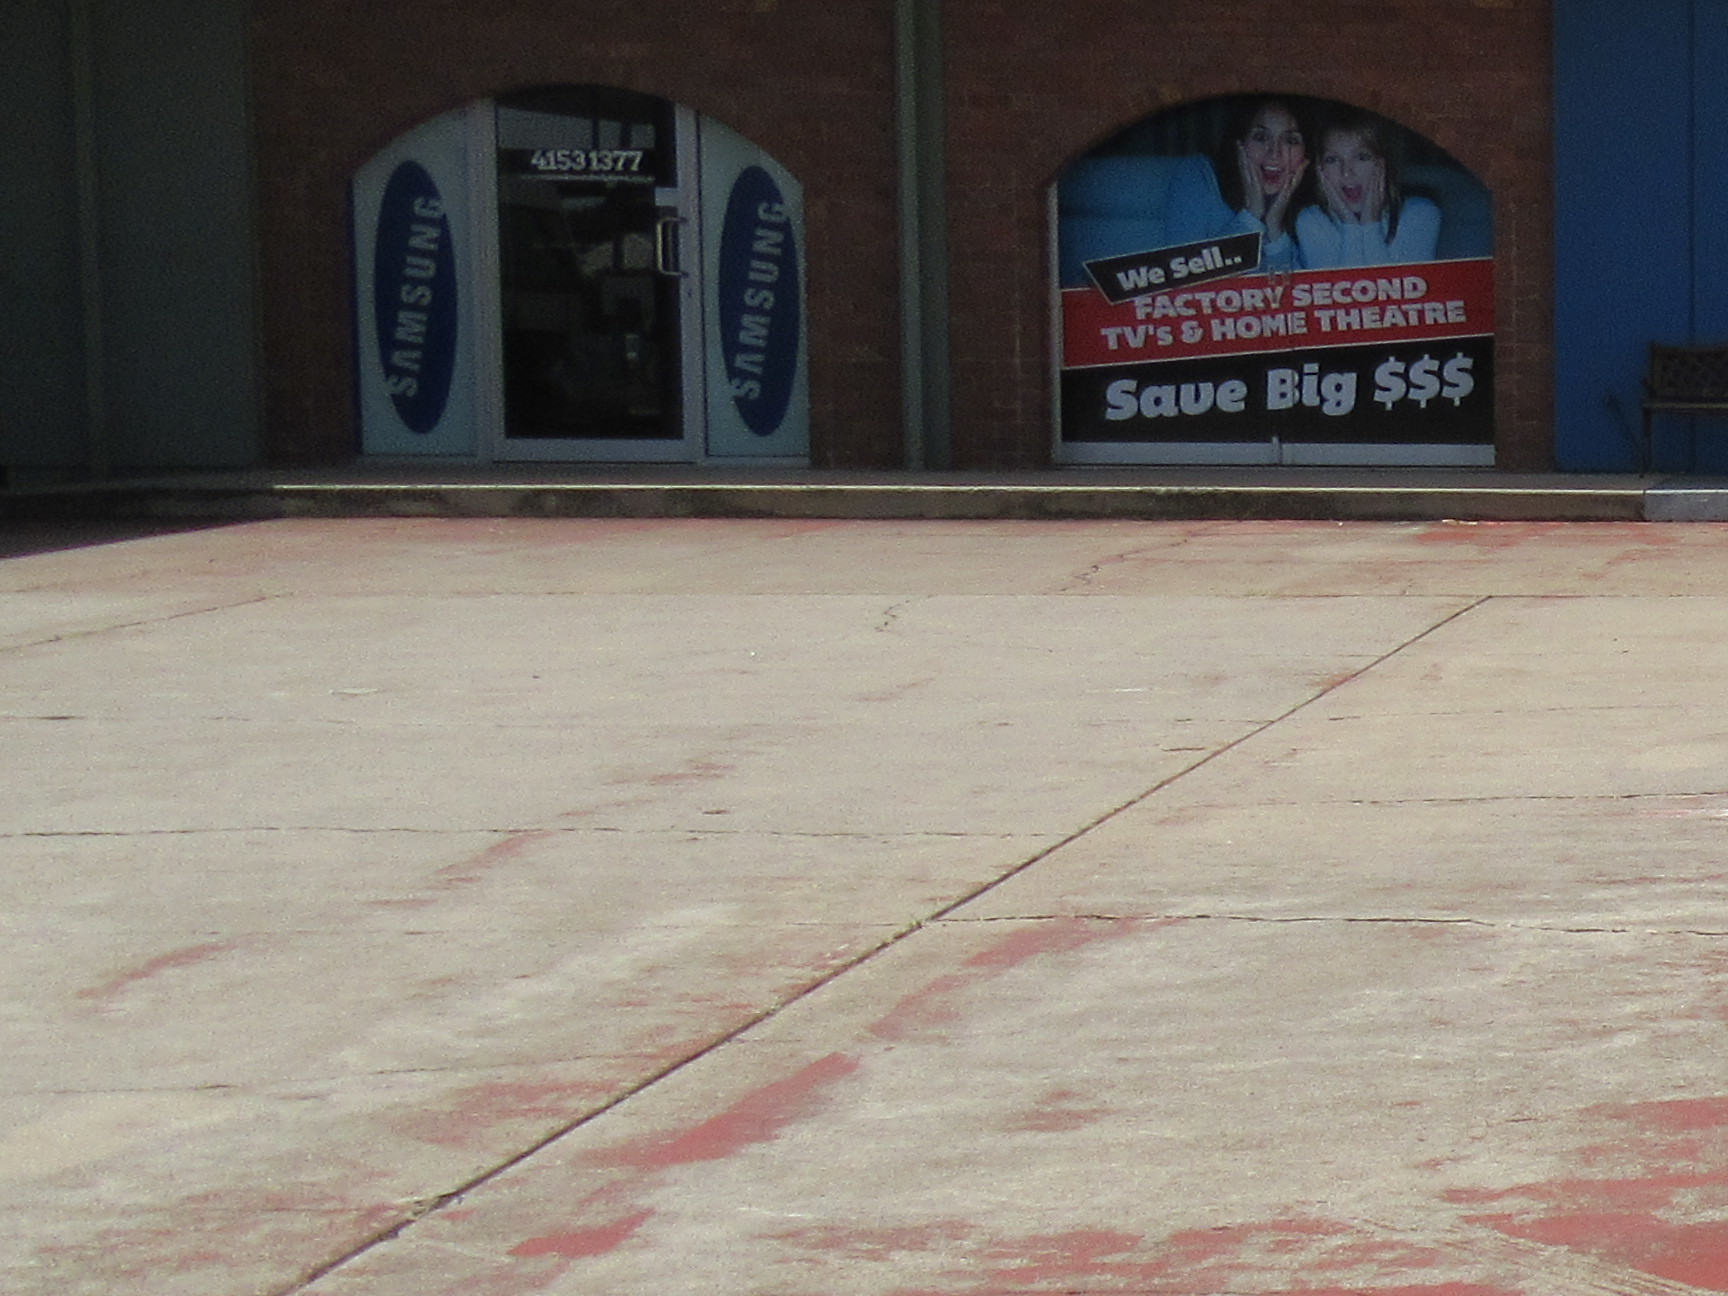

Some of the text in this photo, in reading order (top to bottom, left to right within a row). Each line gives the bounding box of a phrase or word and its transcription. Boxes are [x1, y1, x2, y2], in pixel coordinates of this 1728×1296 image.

[385, 196, 444, 398] SAMSUNG
[728, 200, 789, 401] SAMSUNG
[1116, 265, 1166, 292] We
[1134, 276, 1428, 320] FACTORY SECOND
[1102, 300, 1467, 350] TV's & HOME THEATRE
[1105, 352, 1475, 421] Save Big $$$
